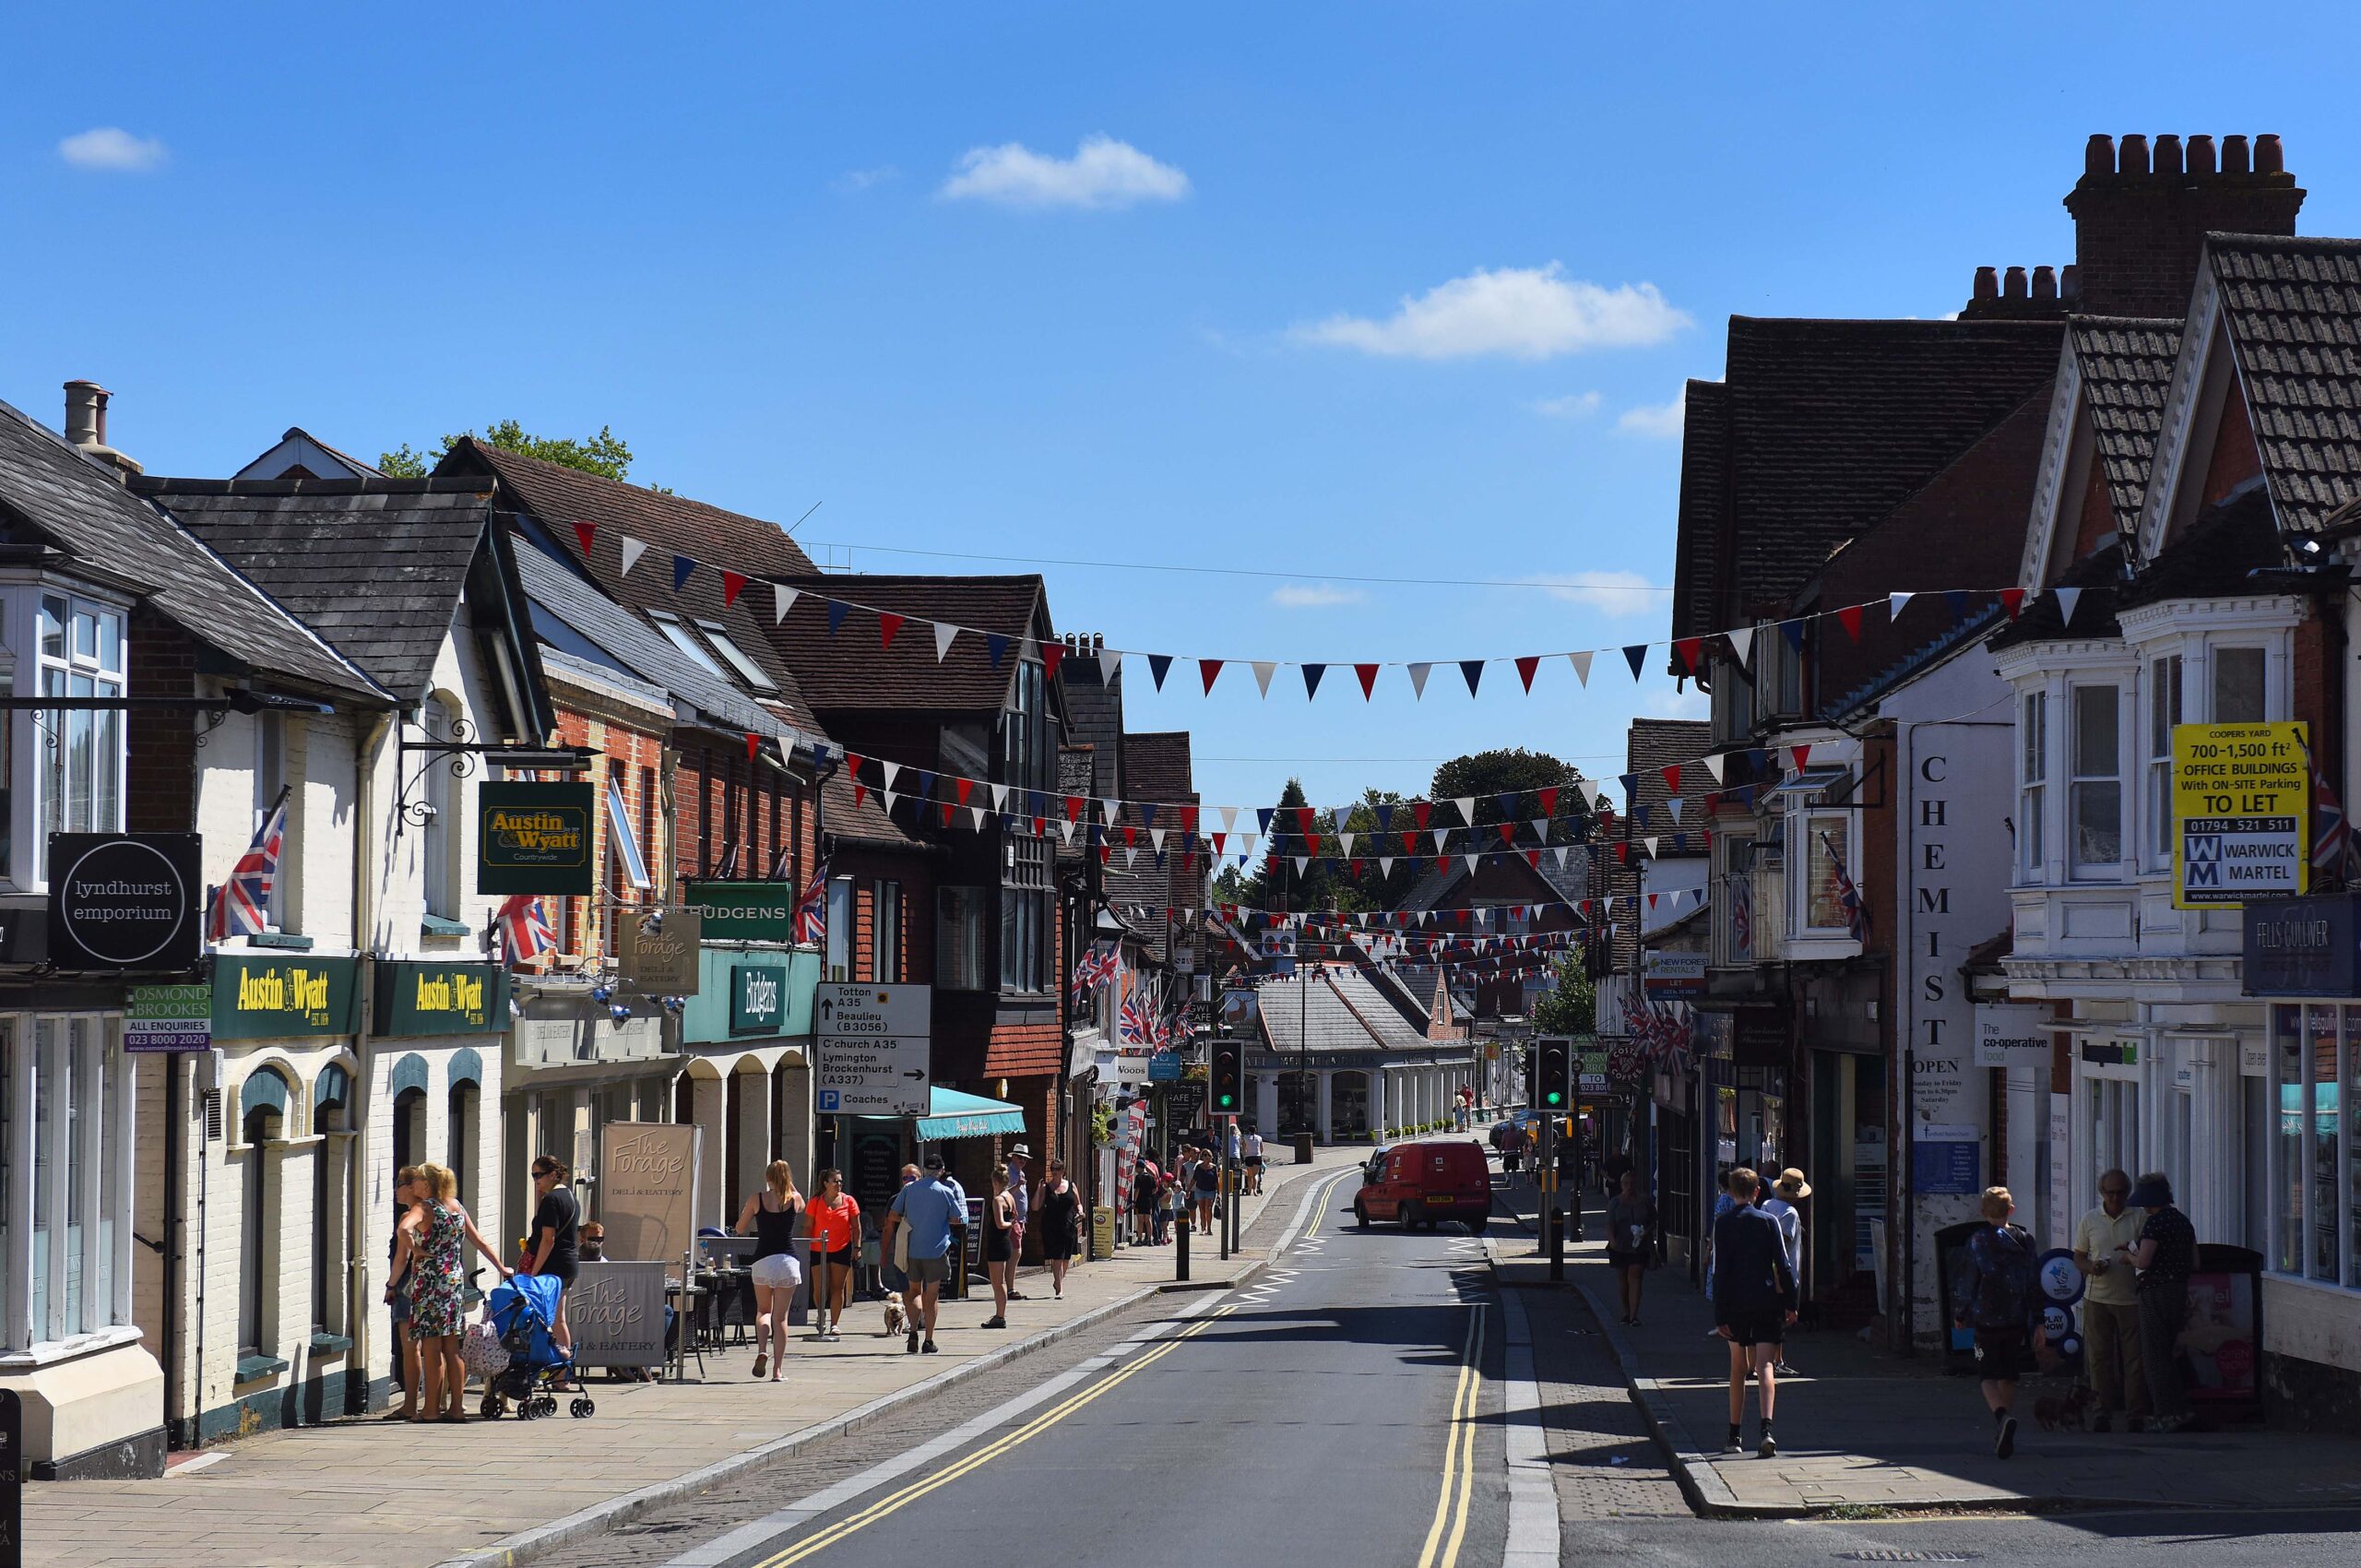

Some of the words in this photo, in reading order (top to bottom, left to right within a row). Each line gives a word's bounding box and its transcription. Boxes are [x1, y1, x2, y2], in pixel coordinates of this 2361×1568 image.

[2184, 764, 2226, 776] OFFICE
[2232, 763, 2297, 775] BUILDINGS
[2181, 780, 2208, 790] With
[2212, 779, 2255, 790] ON-SITE
[2260, 778, 2301, 791] Parking
[2203, 795, 2232, 813] TO
[2242, 794, 2278, 813] LET
[491, 812, 564, 831] Austin
[2190, 821, 2228, 831] 01794
[2237, 820, 2259, 830] 521
[2268, 819, 2290, 830] 511
[518, 831, 580, 852] Wyatt
[513, 853, 558, 861] Countrywide
[2224, 844, 2295, 858] WARWICK
[2229, 866, 2290, 880] MARTEL
[75, 881, 172, 898] lyndhurst
[1916, 756, 1950, 1045] CHEMIST
[2190, 892, 2290, 900] www.warwickmartel.com
[74, 906, 172, 923] emporium
[2257, 922, 2280, 947] FELLS
[2284, 920, 2329, 946] GULLIVER
[635, 934, 687, 963] Forage
[1661, 966, 1697, 974] RENTALS
[135, 987, 208, 1001] OSMOND
[238, 967, 283, 1011] Austin
[292, 968, 328, 1018] Wyatt
[416, 973, 450, 1011] Austin
[457, 974, 482, 1017] Wyatt
[745, 971, 777, 1022] Budgens
[837, 987, 872, 996] Totton
[837, 999, 861, 1007] A35
[136, 1003, 208, 1016] BROOKES
[836, 1012, 882, 1021] Beaulieu
[1187, 1014, 1212, 1022] CAFE
[129, 1021, 148, 1031] ALL
[150, 1020, 206, 1032] ENQUIRIES
[836, 1021, 888, 1032] (B3056)
[1983, 1024, 1999, 1035] The
[128, 1034, 148, 1045] 023
[151, 1034, 177, 1044] 8000
[179, 1033, 206, 1044] 2020
[823, 1039, 870, 1049] C'church
[873, 1039, 897, 1049] A35
[1983, 1038, 2047, 1050] co-operative
[823, 1052, 877, 1063] Lymington
[1585, 1053, 1608, 1063] OSM
[1613, 1047, 1639, 1058] COSTA
[1984, 1051, 2005, 1062] food
[823, 1064, 893, 1074] Brockenhurst
[1912, 1060, 1960, 1075] OPEN
[1589, 1075, 1602, 1083] TO
[1611, 1067, 1643, 1081] COFFEE
[822, 1075, 864, 1086] (A337)
[1914, 1079, 1933, 1087] onday
[1941, 1079, 1962, 1087] Friday
[824, 1092, 836, 1108] P
[844, 1095, 889, 1104] Coaches
[1167, 1093, 1189, 1102] AFE
[628, 1130, 670, 1156] The
[612, 1143, 685, 1185] Forage
[645, 1188, 684, 1196] EATERY
[583, 1277, 628, 1304] The
[568, 1292, 644, 1337] Forage
[2044, 1315, 2063, 1324] PLAY
[2044, 1323, 2064, 1331] NOW
[587, 1342, 598, 1351] &
[599, 1341, 657, 1351] EATERY
